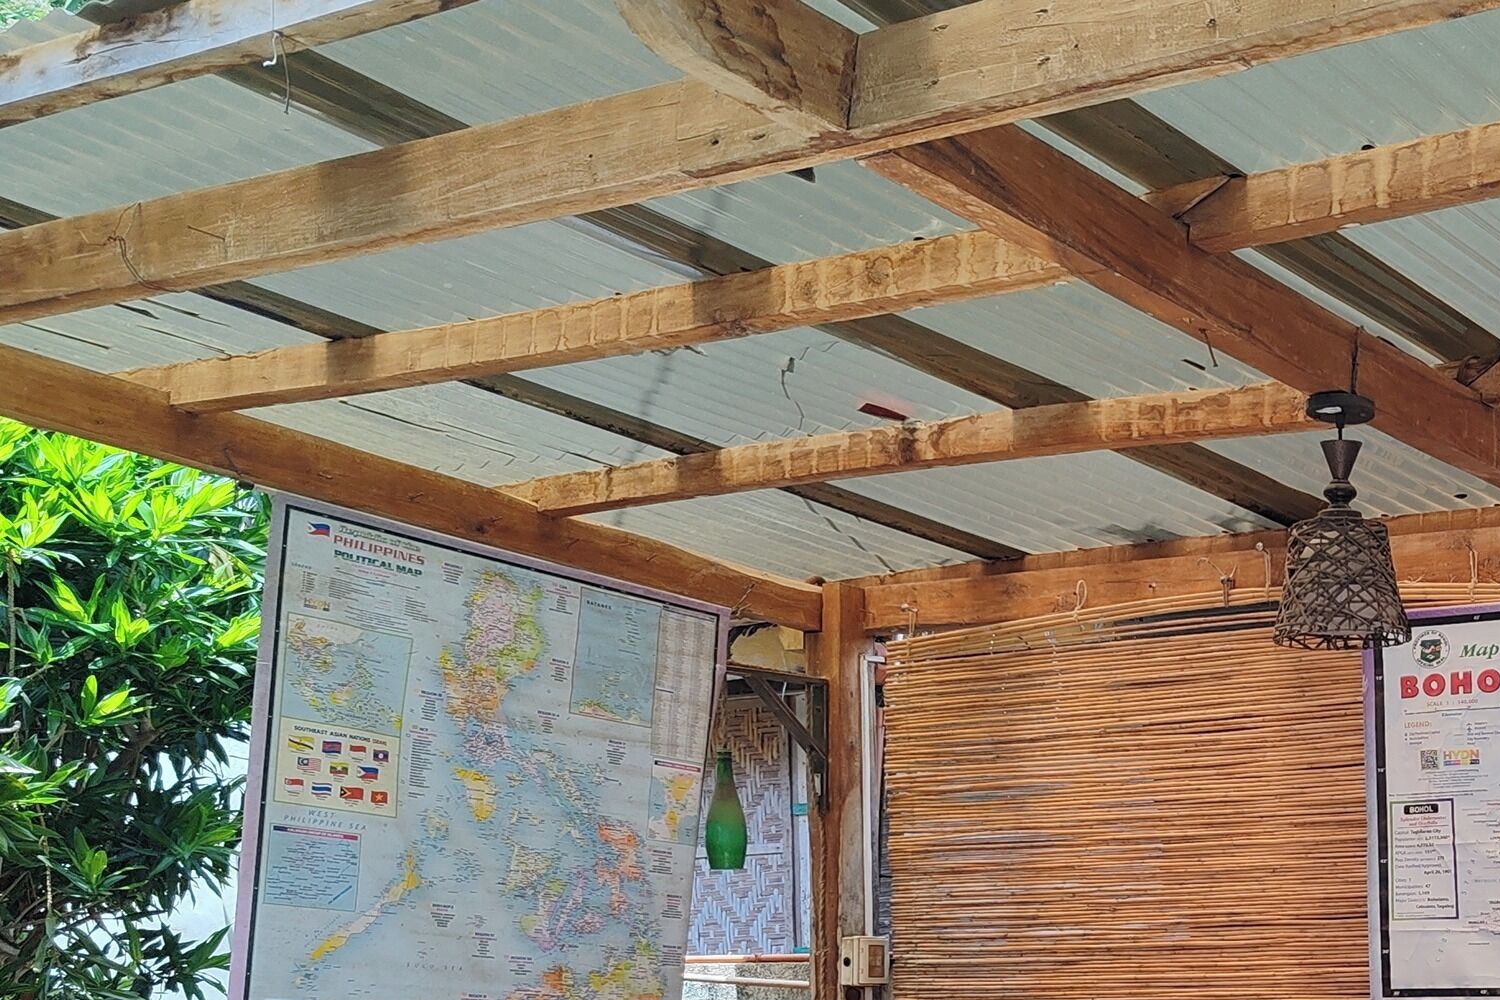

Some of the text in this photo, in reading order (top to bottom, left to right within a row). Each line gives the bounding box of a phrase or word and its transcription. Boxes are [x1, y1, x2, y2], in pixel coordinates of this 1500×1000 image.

[334, 534, 425, 565] PHILIPPINES
[334, 549, 394, 571] POLITICAL
[396, 563, 423, 577] MAP
[1459, 642, 1500, 659] Map
[293, 725, 328, 736] SOUTHEAST
[330, 731, 348, 739] ASIAN
[349, 734, 371, 743] NATIONS
[308, 809, 336, 819] WEST
[1409, 805, 1434, 813] BOHOL
[284, 814, 368, 831] PHILIPPINE SEA
